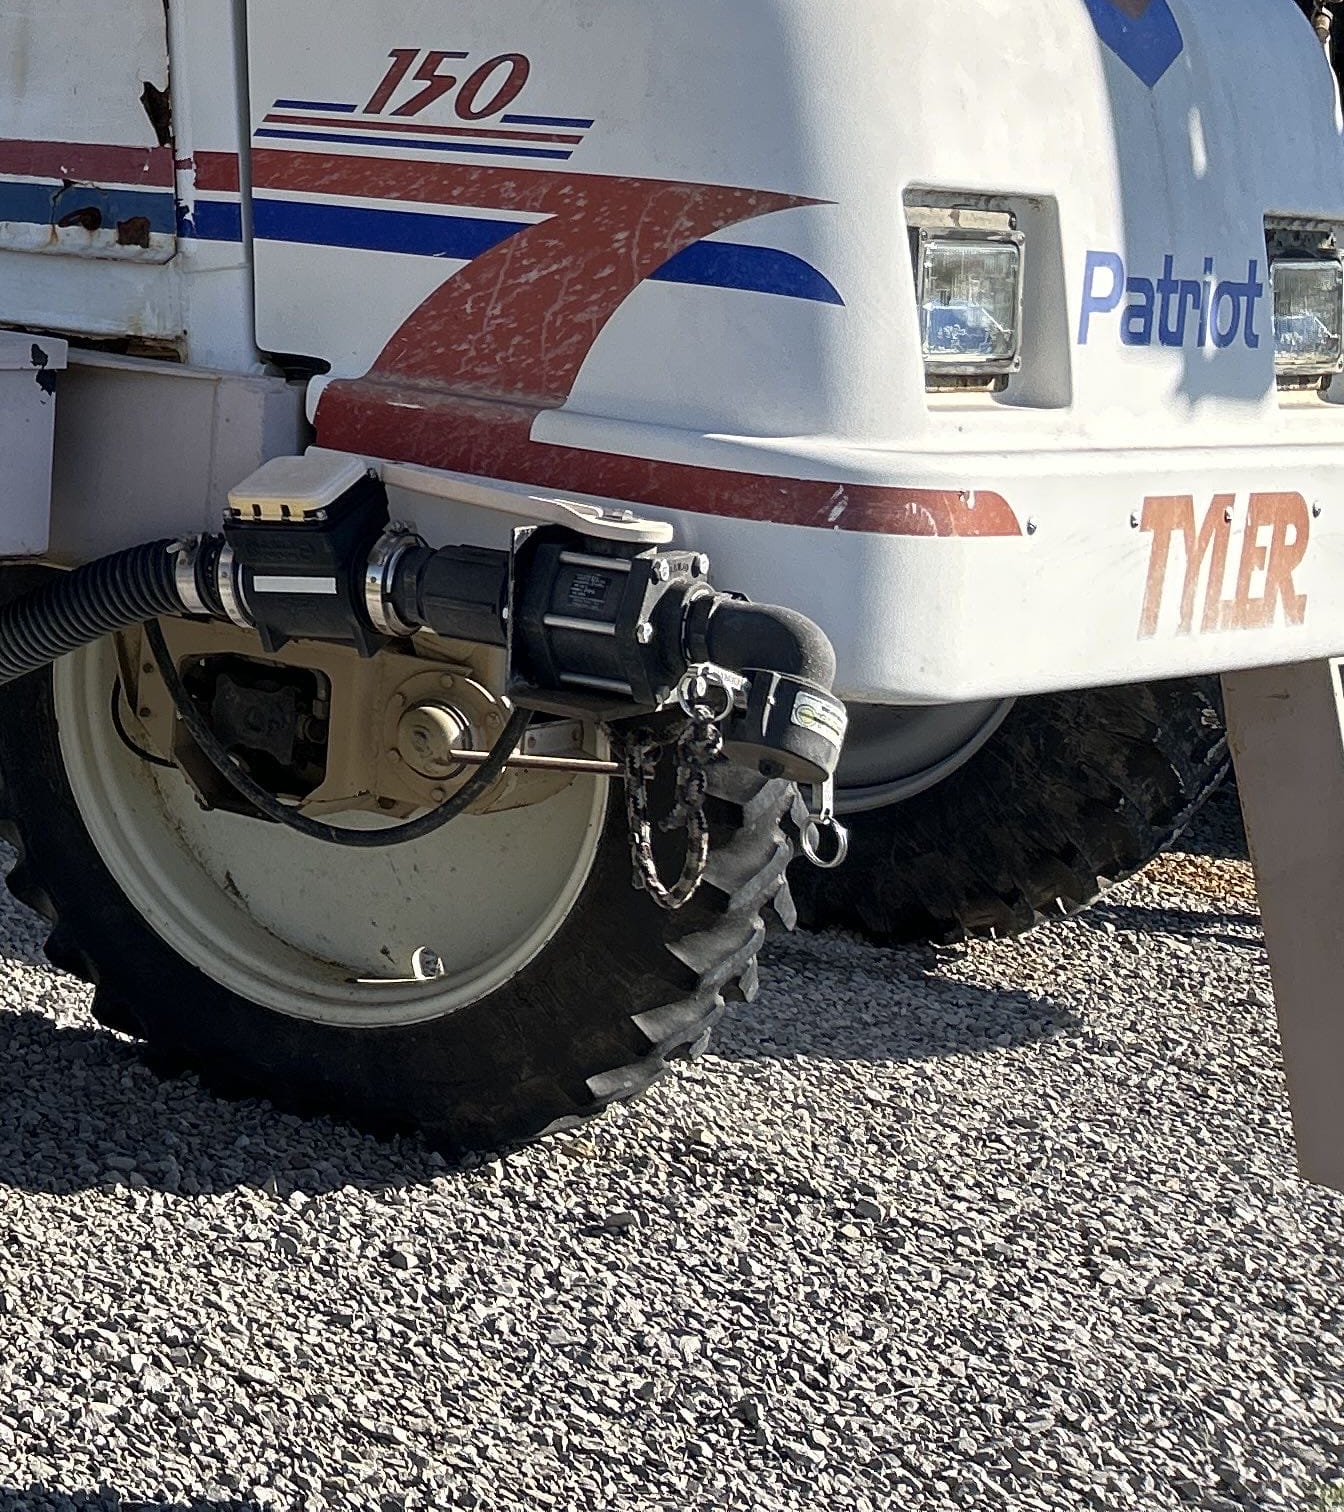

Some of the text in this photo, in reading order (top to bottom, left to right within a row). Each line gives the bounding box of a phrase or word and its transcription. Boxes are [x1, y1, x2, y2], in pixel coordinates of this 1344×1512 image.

[362, 48, 531, 121] 150
[1076, 249, 1264, 349] Patriot
[1137, 490, 1311, 641] TYLER
